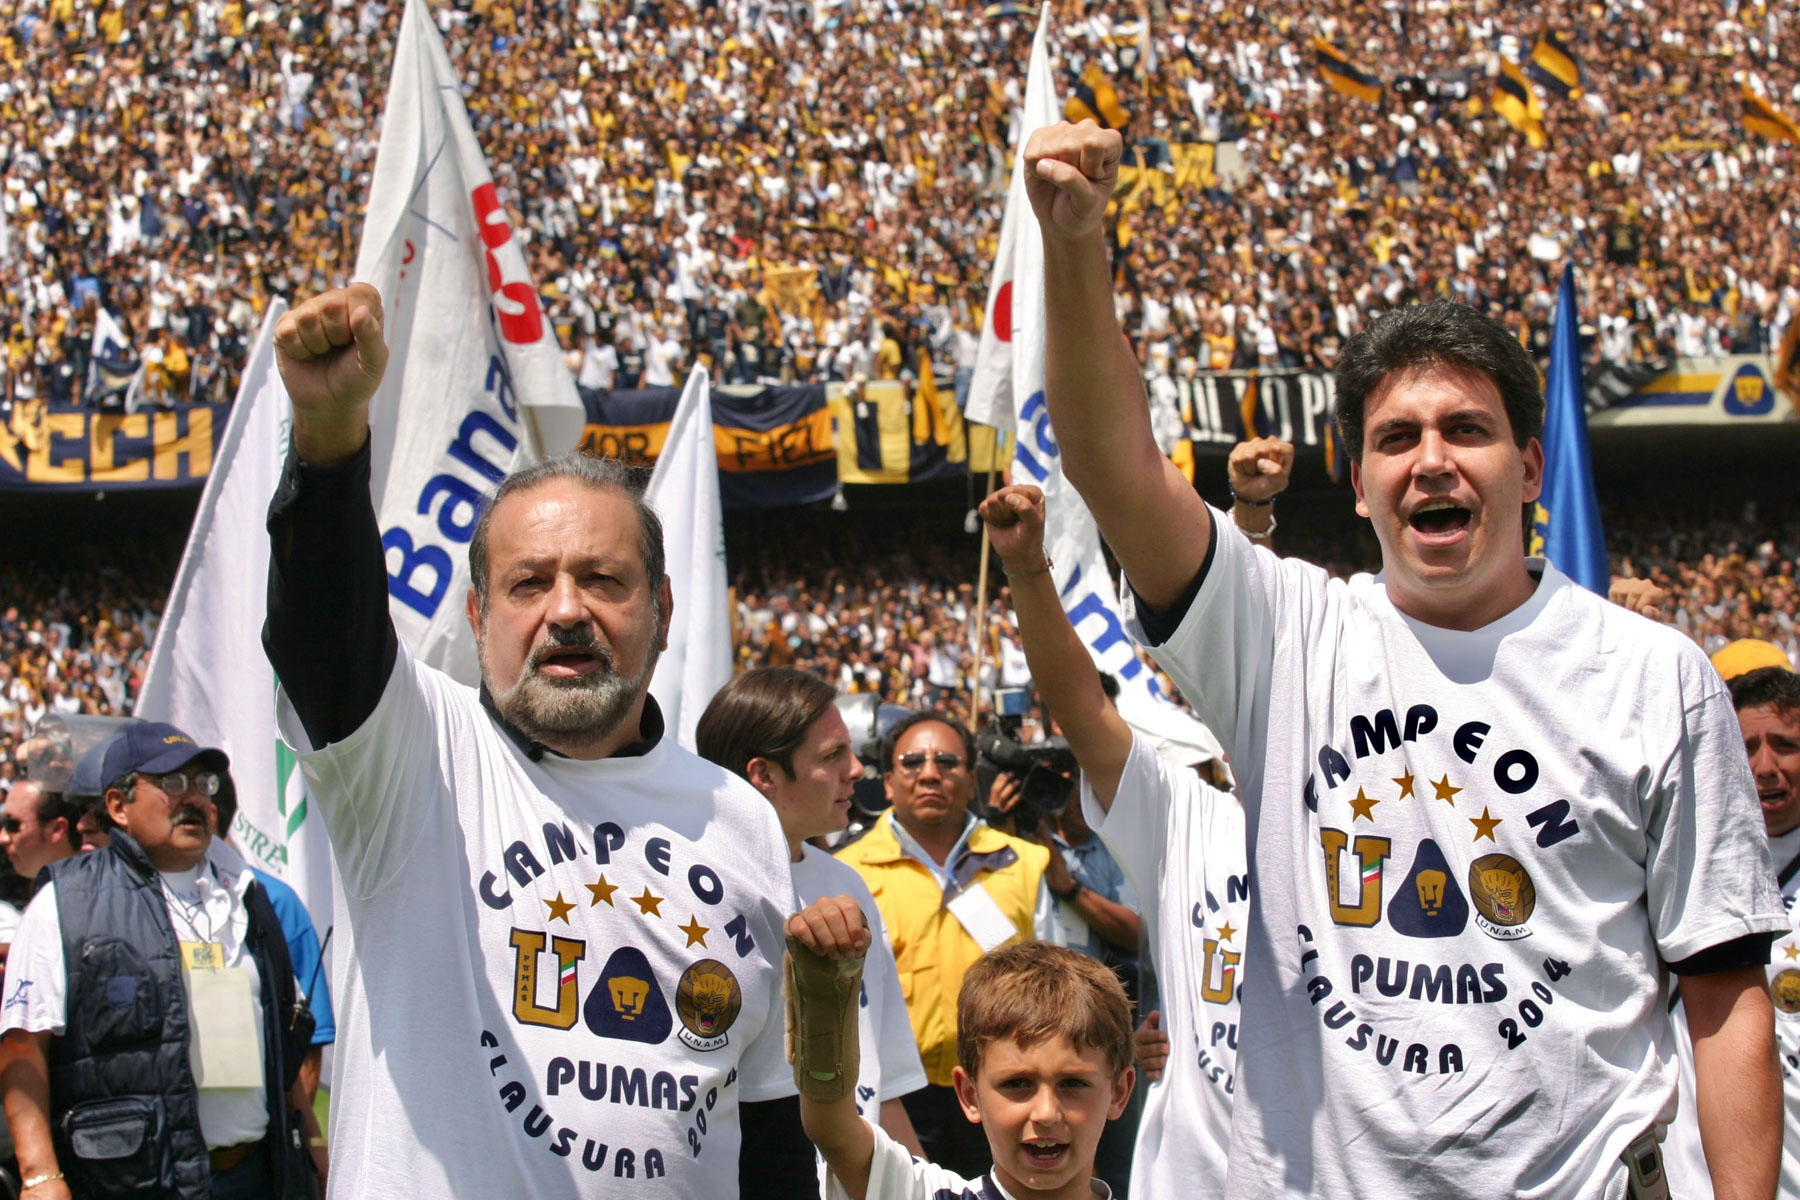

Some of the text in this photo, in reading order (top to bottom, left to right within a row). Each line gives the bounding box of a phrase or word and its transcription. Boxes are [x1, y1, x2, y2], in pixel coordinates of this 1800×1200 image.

[27, 407, 213, 483] CCH
[1304, 704, 1580, 849] CAMPEON
[479, 822, 755, 958] CAMPEON
[521, 954, 530, 1002] PUMAS
[1297, 924, 1573, 1075] CLAUSURA 2004
[1351, 953, 1508, 1005] PUMAS
[480, 1029, 738, 1180] CLAUSURA 2004
[546, 1056, 700, 1112] PUMAS
